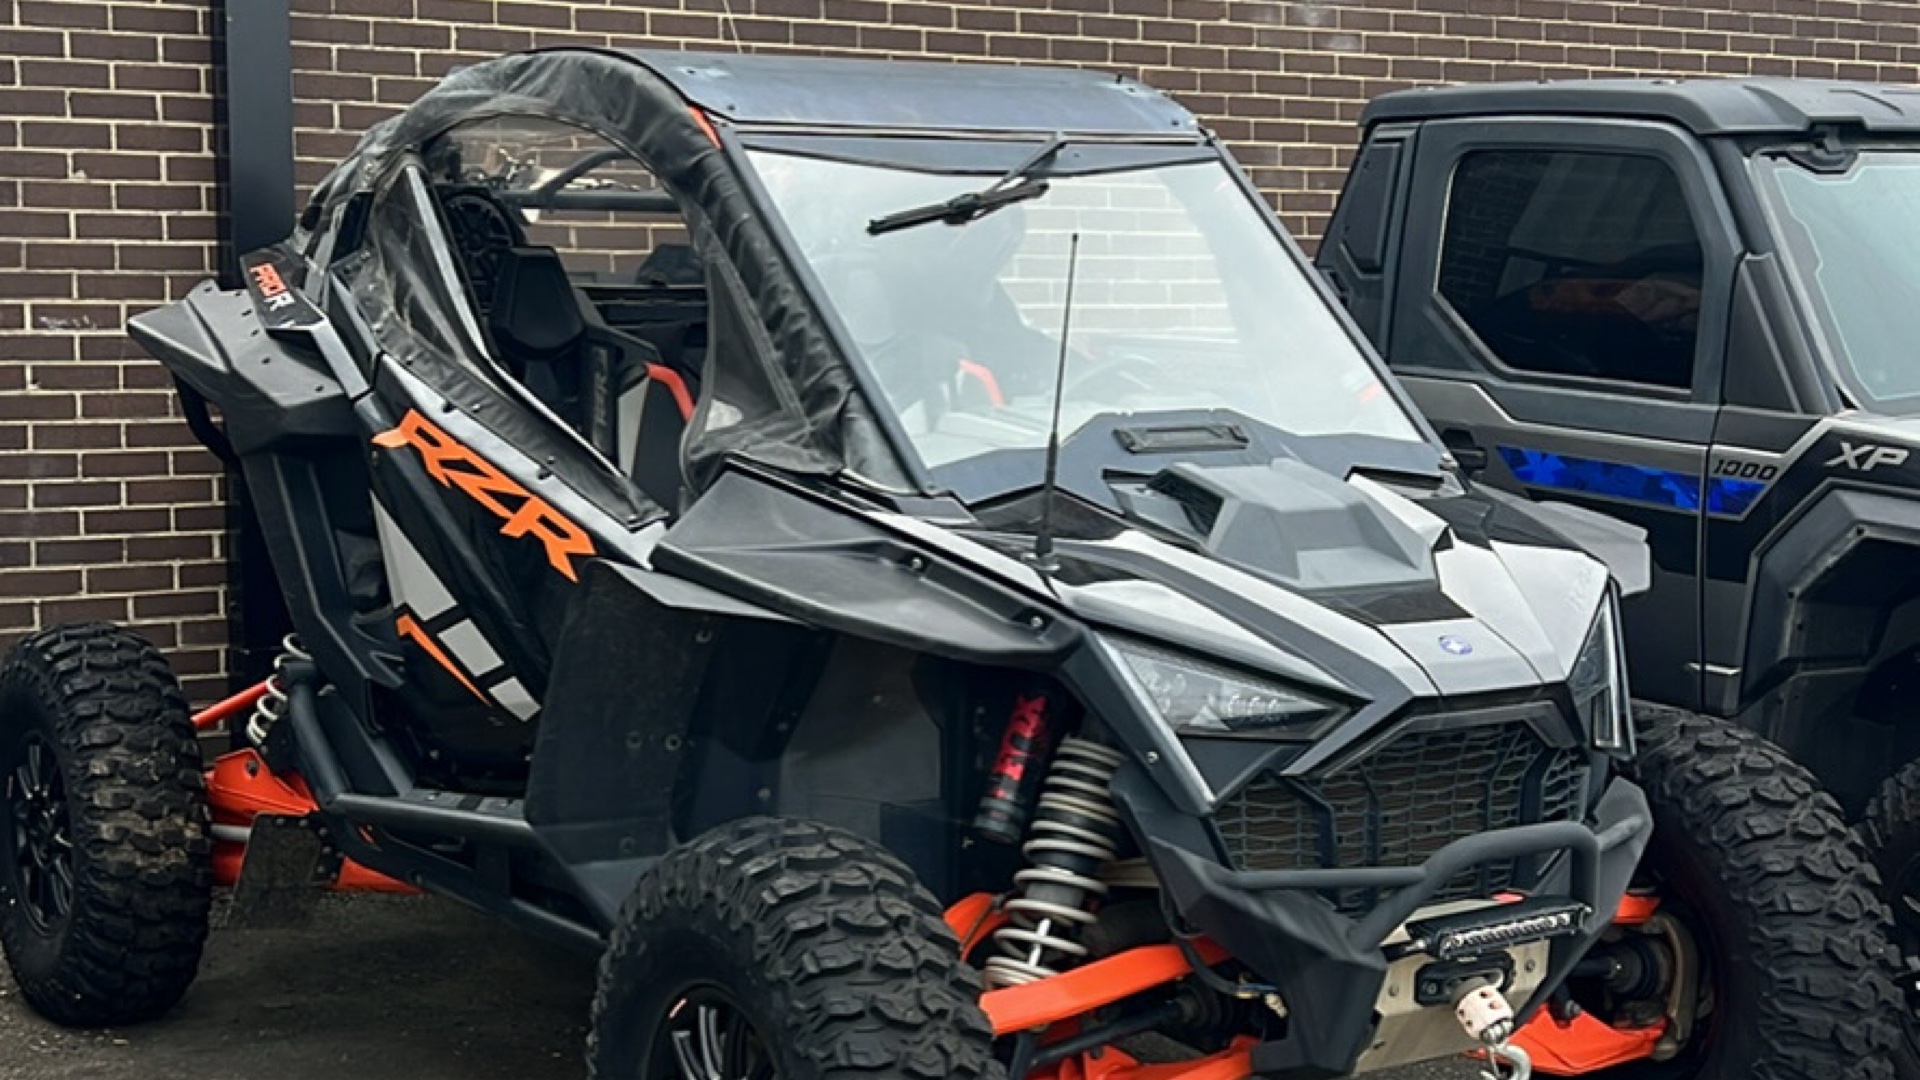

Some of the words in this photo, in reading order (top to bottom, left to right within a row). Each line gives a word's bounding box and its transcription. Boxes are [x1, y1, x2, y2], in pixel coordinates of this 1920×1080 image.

[1714, 459, 1779, 480] 1000
[1824, 442, 1910, 471] XP
[371, 408, 597, 583] RZR
